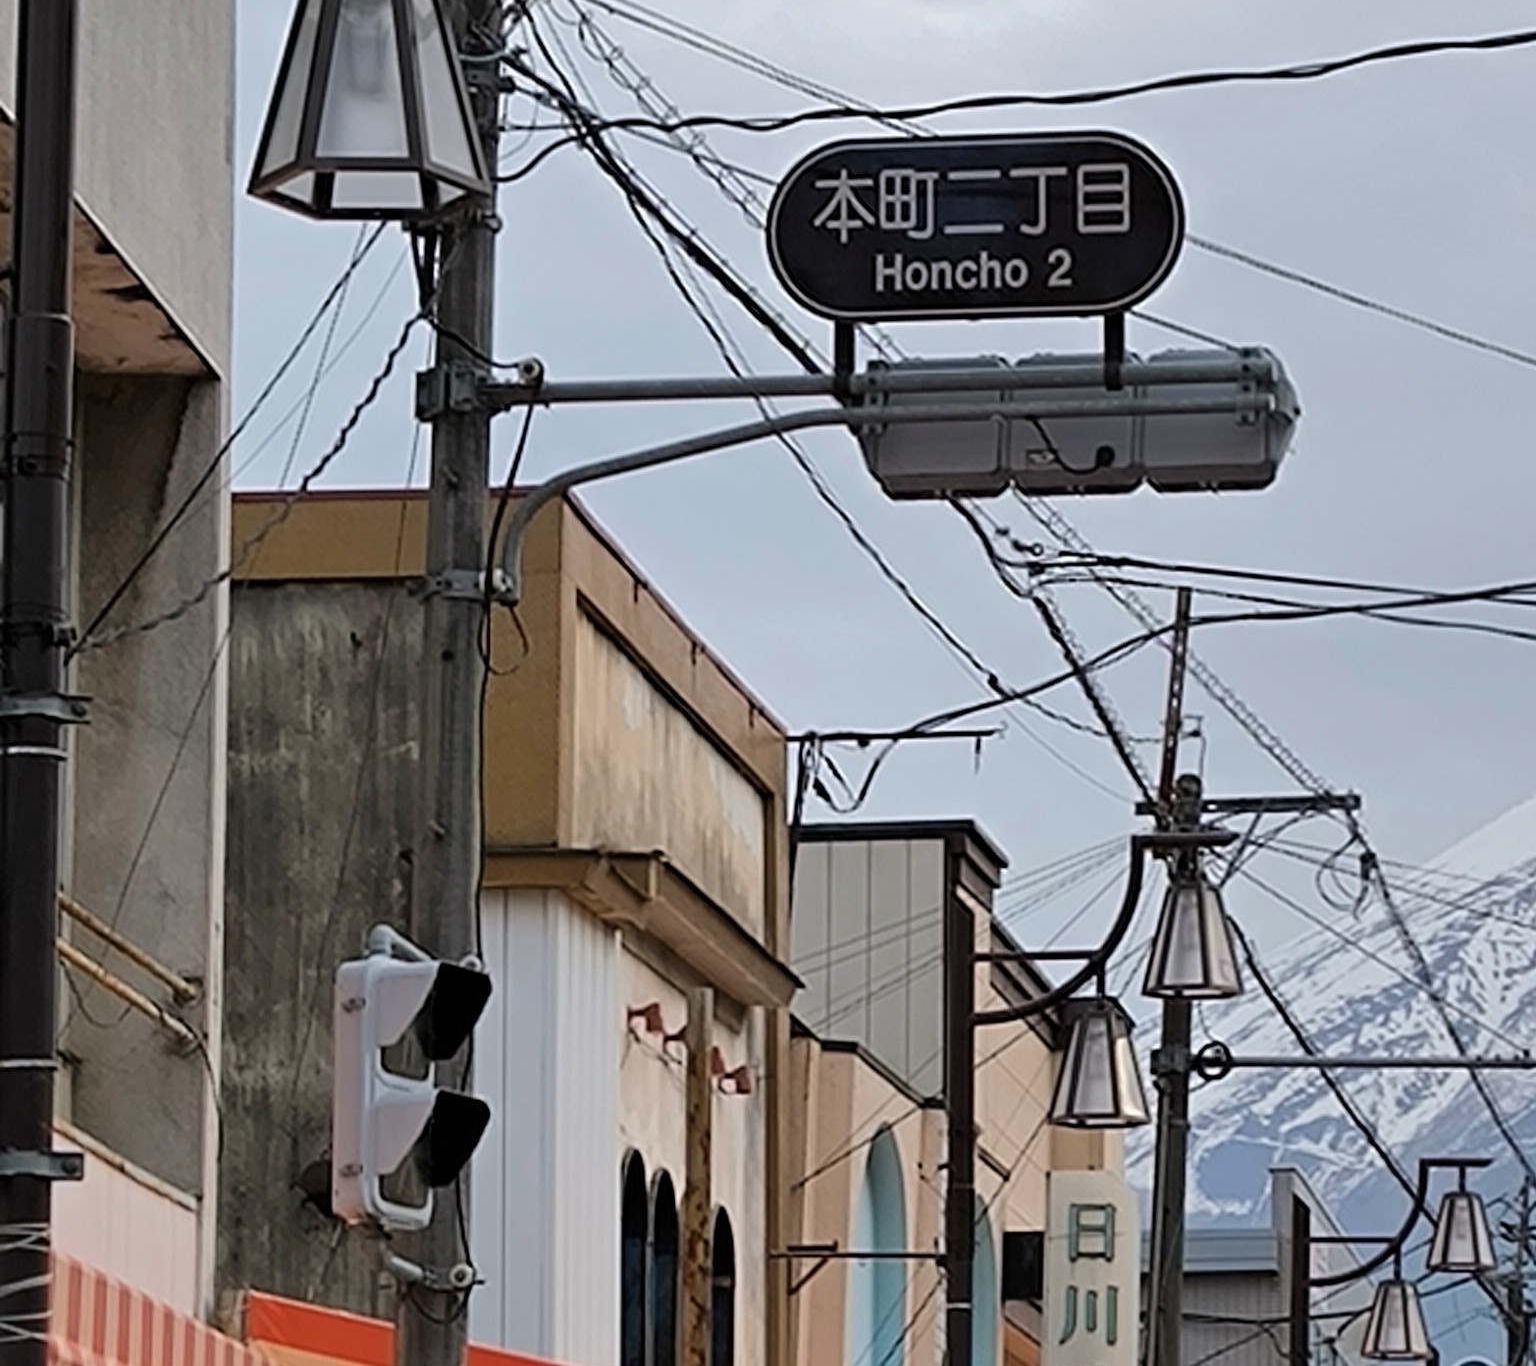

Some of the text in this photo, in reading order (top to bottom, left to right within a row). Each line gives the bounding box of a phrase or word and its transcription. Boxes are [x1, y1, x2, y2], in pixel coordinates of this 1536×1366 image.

[812, 163, 1131, 244] 本町二丁目
[875, 248, 1074, 292] Honcho 2
